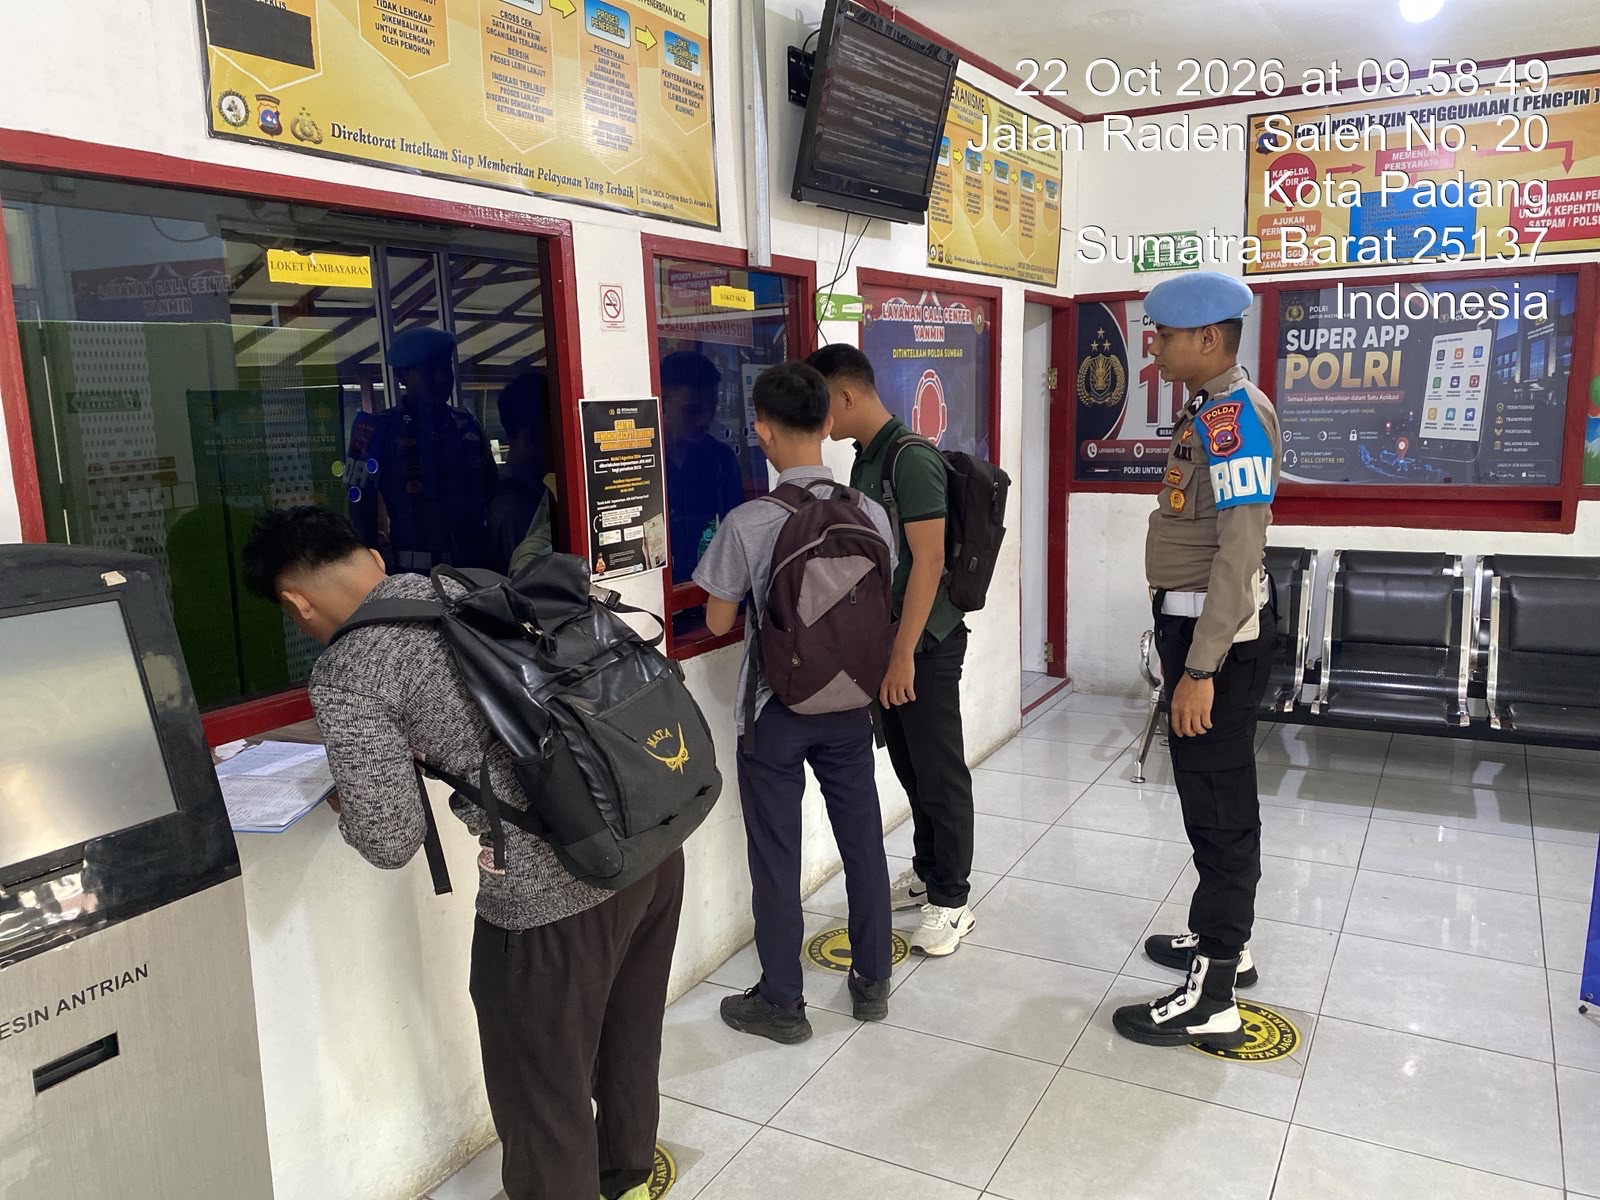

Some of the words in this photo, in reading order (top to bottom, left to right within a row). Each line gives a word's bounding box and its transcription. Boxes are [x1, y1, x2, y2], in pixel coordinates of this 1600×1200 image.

[376, 0, 398, 12] TIDAK
[399, 6, 432, 23] LENGKAP
[500, 10, 520, 23] CROSS
[520, 17, 533, 28] CEK
[596, 8, 620, 25] PROSES
[673, 9, 686, 22] SKCK
[375, 23, 398, 36] UNTUK
[399, 30, 436, 47] DILENGKAPI
[381, 14, 428, 35] DIKEMBALIKAN
[492, 19, 506, 29] DATA
[506, 25, 527, 37] PELAKU
[590, 16, 626, 40] PENERBITAN
[382, 35, 399, 47] OLEH
[400, 41, 430, 56] PEMOHON
[485, 27, 517, 43] ORGANISASI
[518, 37, 548, 54] TERLARANG
[507, 47, 529, 60] BERSIH
[593, 44, 625, 61] PENGETIKAN
[490, 54, 511, 66] PROSES
[527, 66, 546, 77] LANJUT
[491, 72, 519, 87] INDIKASI
[519, 80, 546, 95] TERLIBAT
[661, 68, 693, 86] PENYERAHAN
[692, 79, 705, 91] SKCK
[663, 80, 682, 92] KEPADA
[681, 88, 704, 101] PEMOHON
[1379, 111, 1407, 129] IZIN
[1409, 98, 1510, 124] PENGGUNAAN
[1522, 89, 1592, 112] PENGPIN
[330, 122, 396, 150] Direktorat
[399, 137, 449, 161] Intelkam
[450, 148, 474, 169] Siap
[476, 154, 535, 180] Memberikan
[536, 167, 582, 187] Pelayanan
[583, 176, 604, 196] Yang
[605, 181, 634, 199] Terbaik
[1272, 215, 1306, 226] AJUKAN
[1528, 218, 1566, 229] SATPAM
[270, 260, 304, 272] LOKET
[307, 263, 369, 275] PEMBAYARAN
[882, 302, 921, 321] LAYANAN
[922, 306, 943, 323] CALL
[943, 307, 972, 325] CENTER
[1309, 305, 1329, 313] POLRI
[913, 324, 945, 343] YANMIN
[1285, 327, 1358, 352] SUPER
[1361, 324, 1410, 349] APP
[892, 348, 927, 359] DITINTELKAM
[927, 349, 943, 358] POLDA
[944, 348, 963, 358] SUMBAR
[1284, 349, 1402, 390] POLRI
[1304, 395, 1325, 403] Layanan
[1379, 394, 1400, 402] Aplikasi
[1206, 405, 1235, 421] POLDA
[1123, 466, 1141, 475] POLRI
[1141, 466, 1163, 475] UNTUK
[1209, 455, 1273, 504] ROV
[646, 727, 673, 749] MATA
[0, 1005, 50, 1041] ESIN
[55, 963, 149, 1017] ANTRIAN
[1258, 1009, 1291, 1033] JARAK
[1278, 1033, 1293, 1051] JAGA
[1238, 1048, 1279, 1060] TETAP
